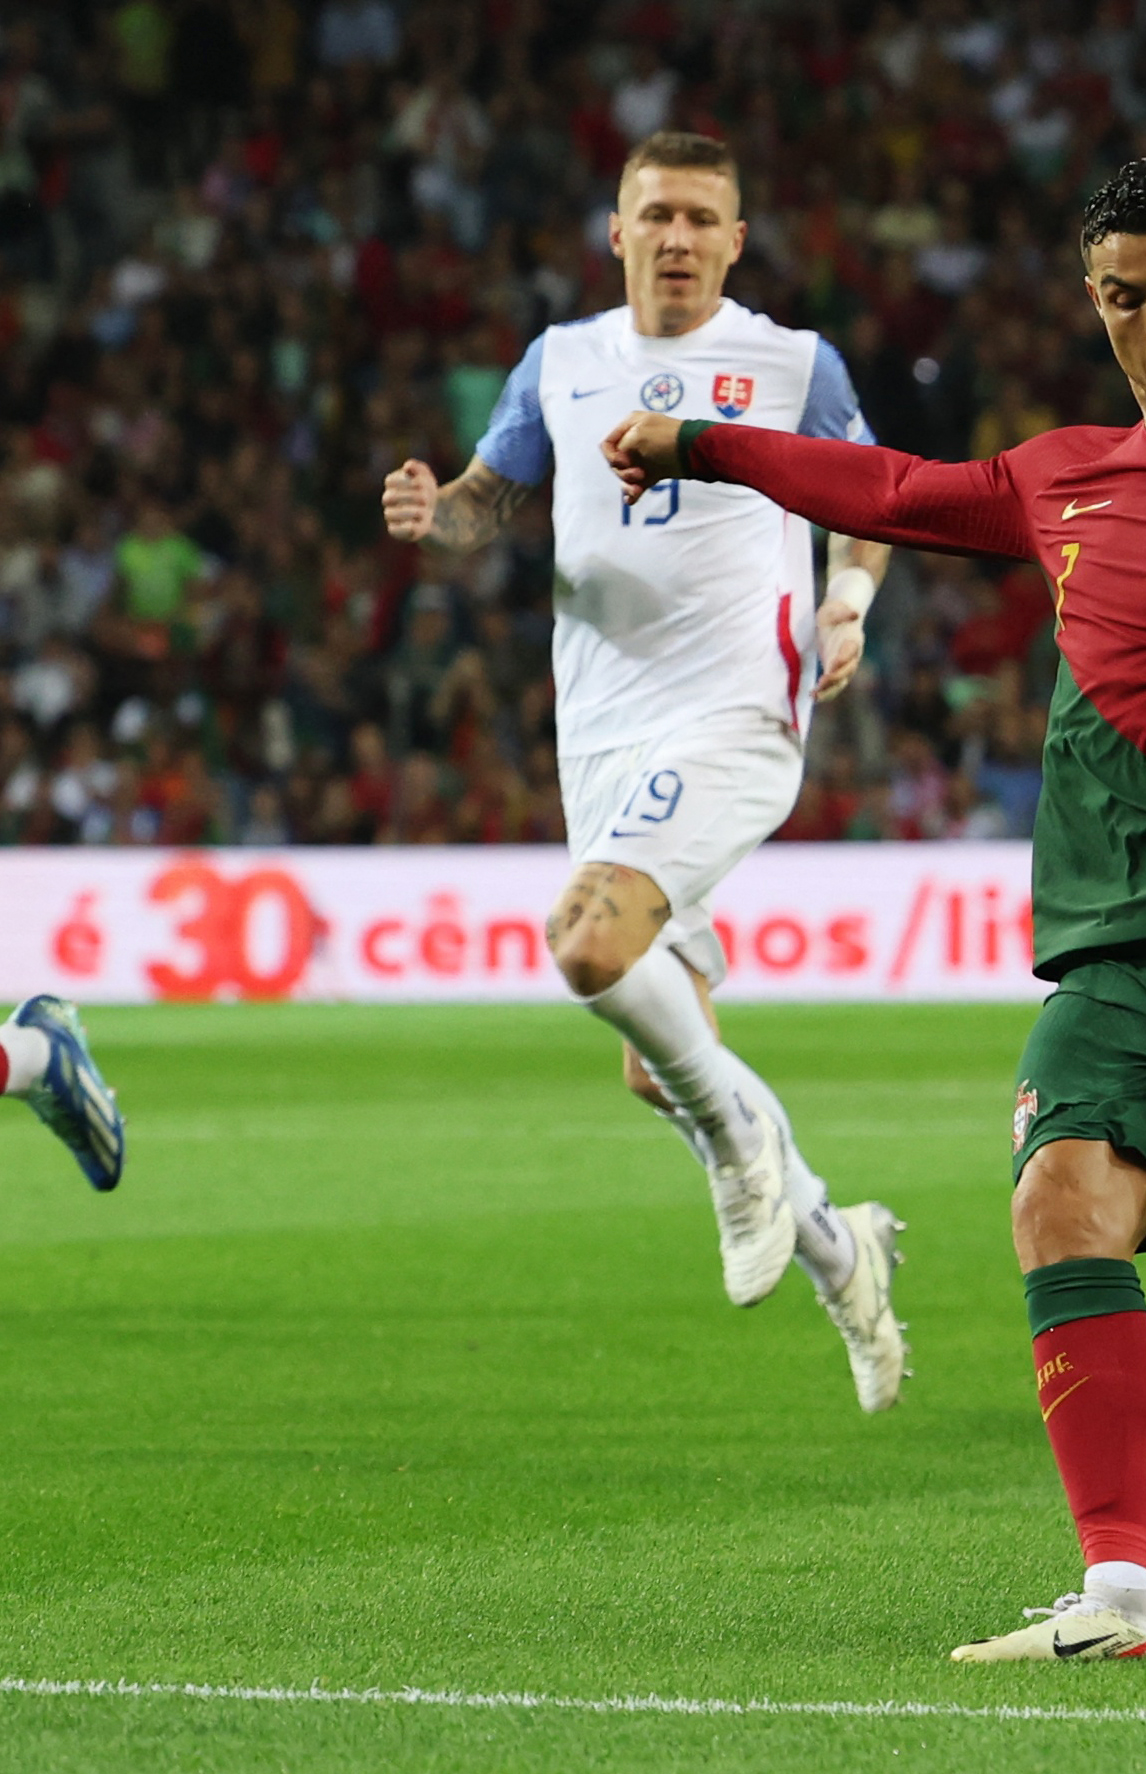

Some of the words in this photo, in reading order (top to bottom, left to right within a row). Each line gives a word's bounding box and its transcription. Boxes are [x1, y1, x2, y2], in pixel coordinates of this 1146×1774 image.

[1056, 542, 1080, 631] 7
[622, 769, 684, 823] 19
[147, 858, 314, 1003] 30
